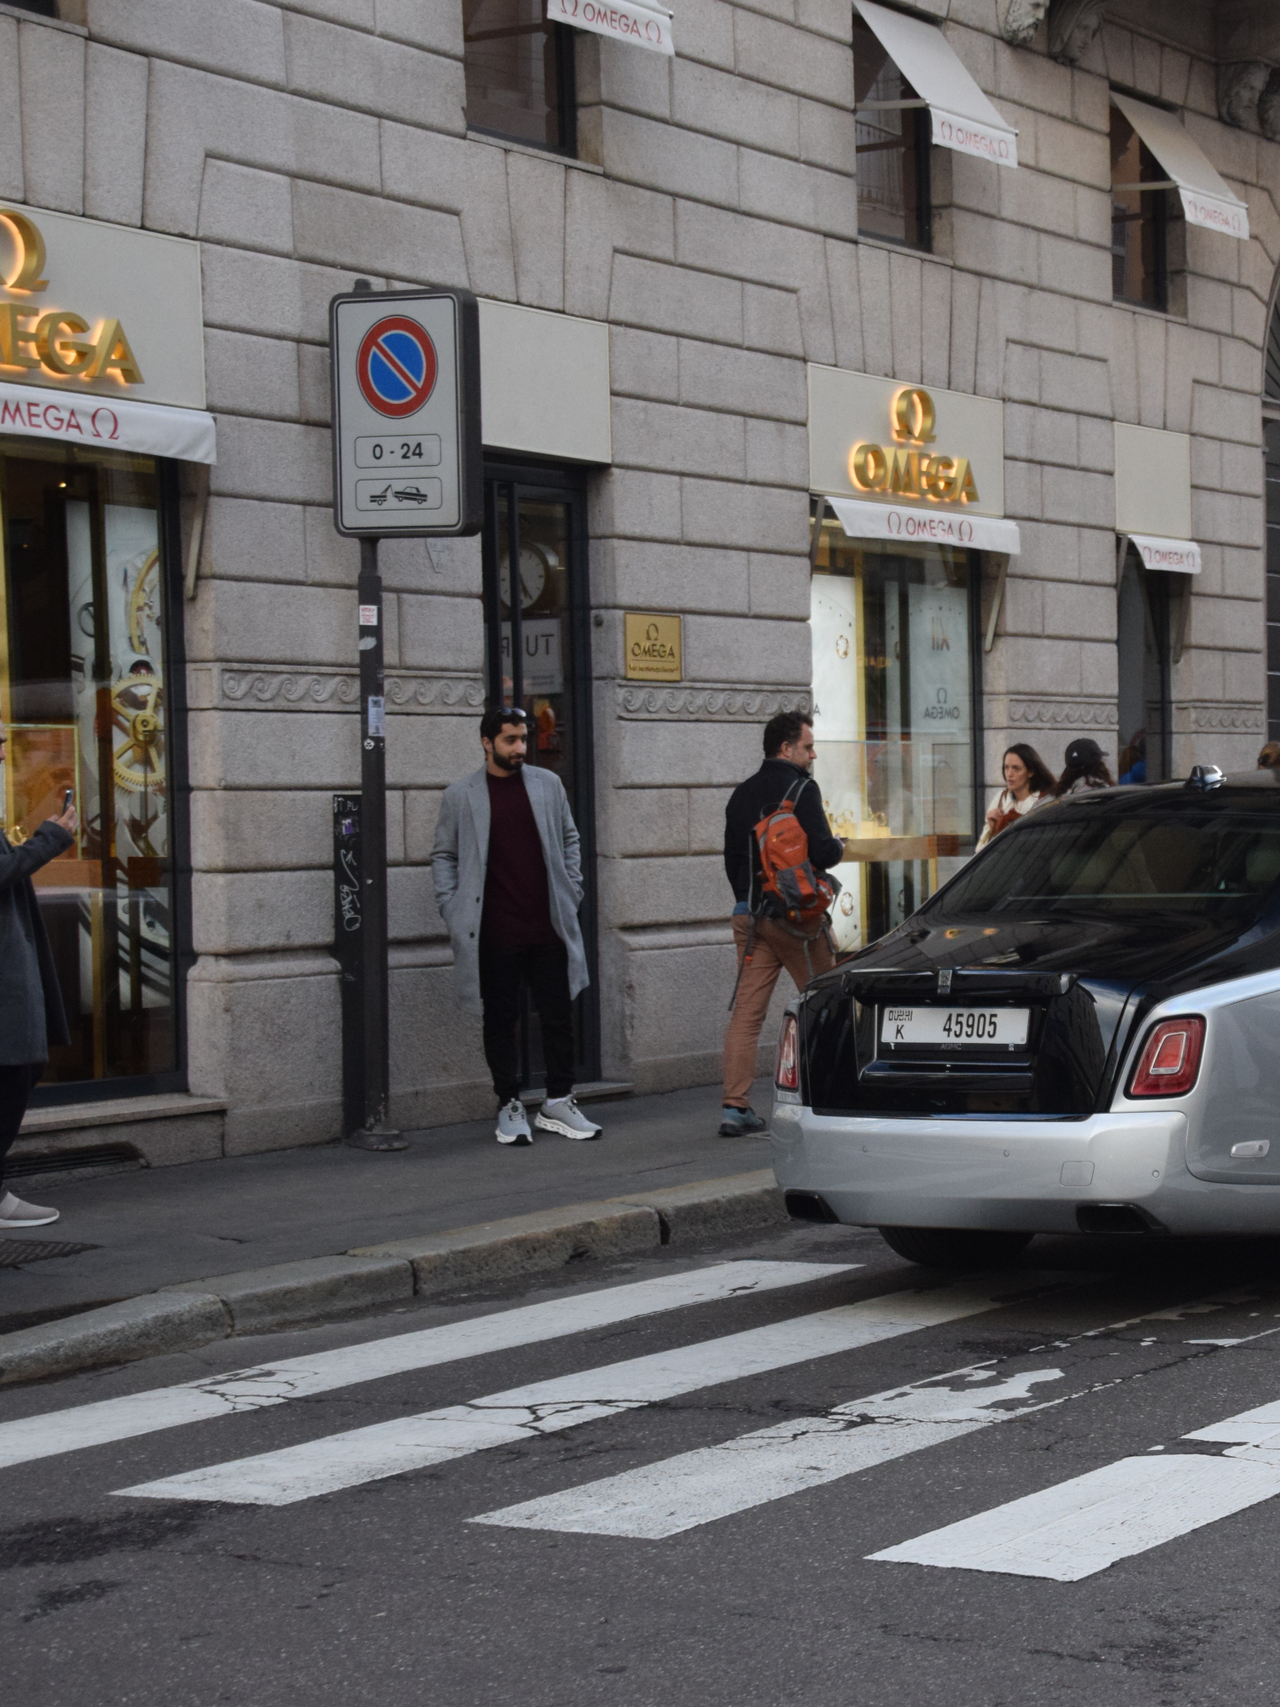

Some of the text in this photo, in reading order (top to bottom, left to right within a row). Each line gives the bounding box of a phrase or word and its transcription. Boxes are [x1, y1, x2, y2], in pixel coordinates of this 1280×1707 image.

[583, 3, 641, 38] OMEGA
[956, 128, 996, 155] OMEGA
[1200, 206, 1230, 228] OMEGA
[0, 303, 145, 384] EGA
[1, 400, 83, 435] MEGA
[372, 443, 384, 460] 0
[400, 442, 424, 460] 24
[853, 444, 980, 503] OMEGA
[905, 517, 954, 538] OMEGA
[1154, 550, 1184, 566] OMEGA
[631, 642, 675, 659] OMEGA
[895, 1024, 905, 1040] K
[942, 1013, 998, 1038] 45905
